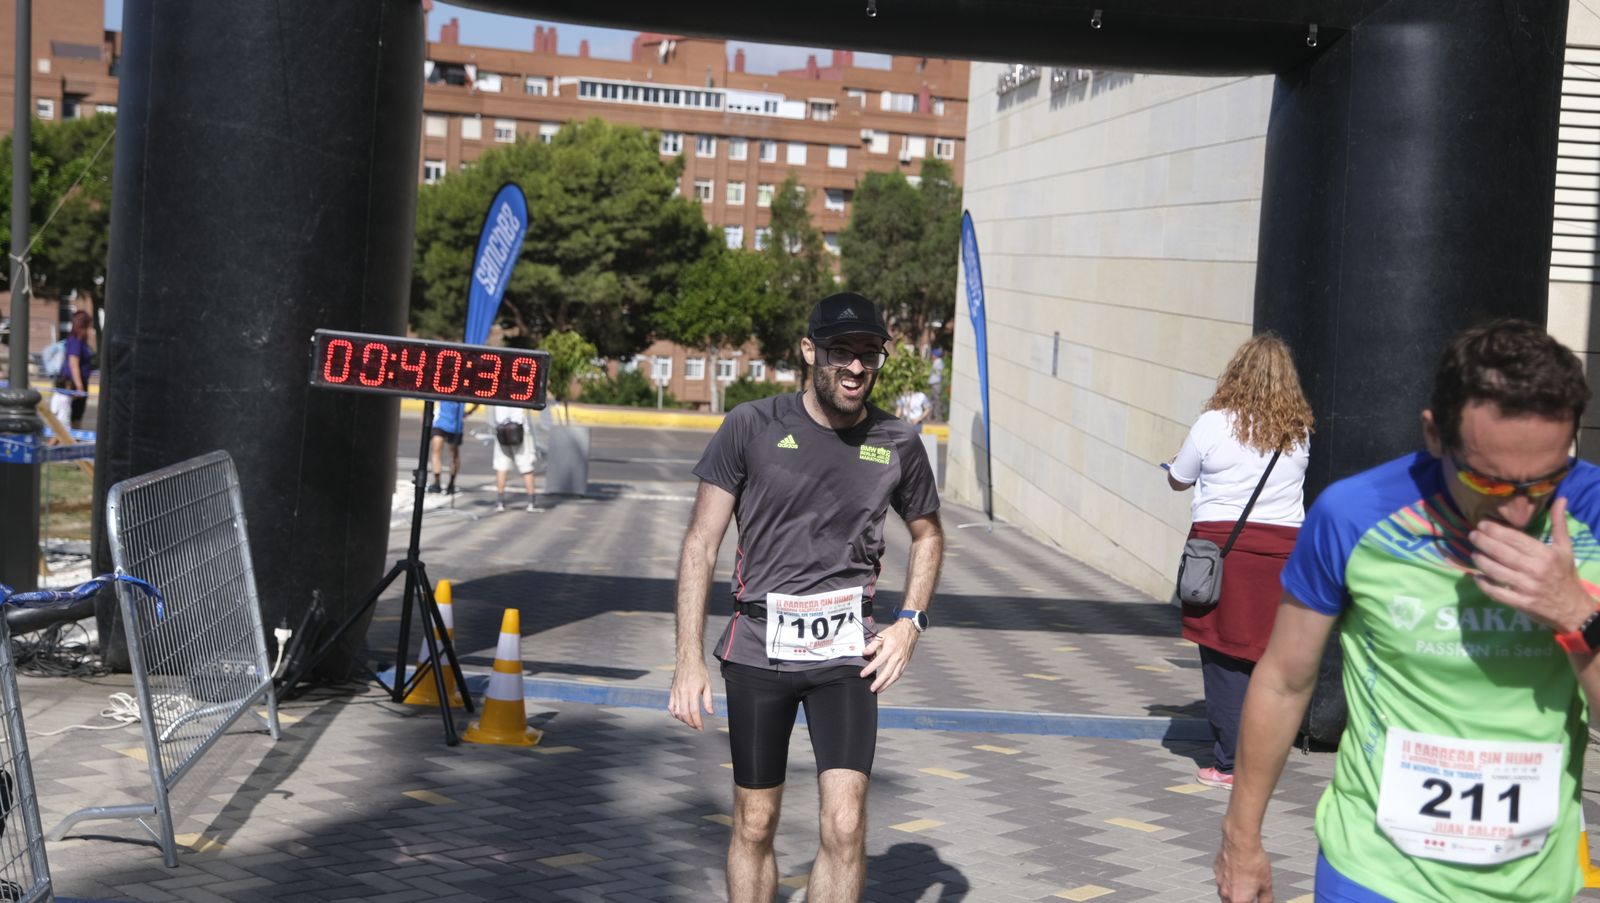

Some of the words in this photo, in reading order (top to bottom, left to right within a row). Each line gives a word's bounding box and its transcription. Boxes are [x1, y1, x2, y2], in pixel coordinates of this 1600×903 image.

[324, 339, 538, 400] 00:40:39
[861, 444, 877, 453] BMW
[791, 612, 846, 640] 107
[1414, 742, 1475, 764] CARRERA
[1479, 751, 1502, 764] SIN
[1505, 752, 1543, 765] HUMO
[1418, 777, 1521, 823] 211
[1432, 821, 1464, 834] JUAN
